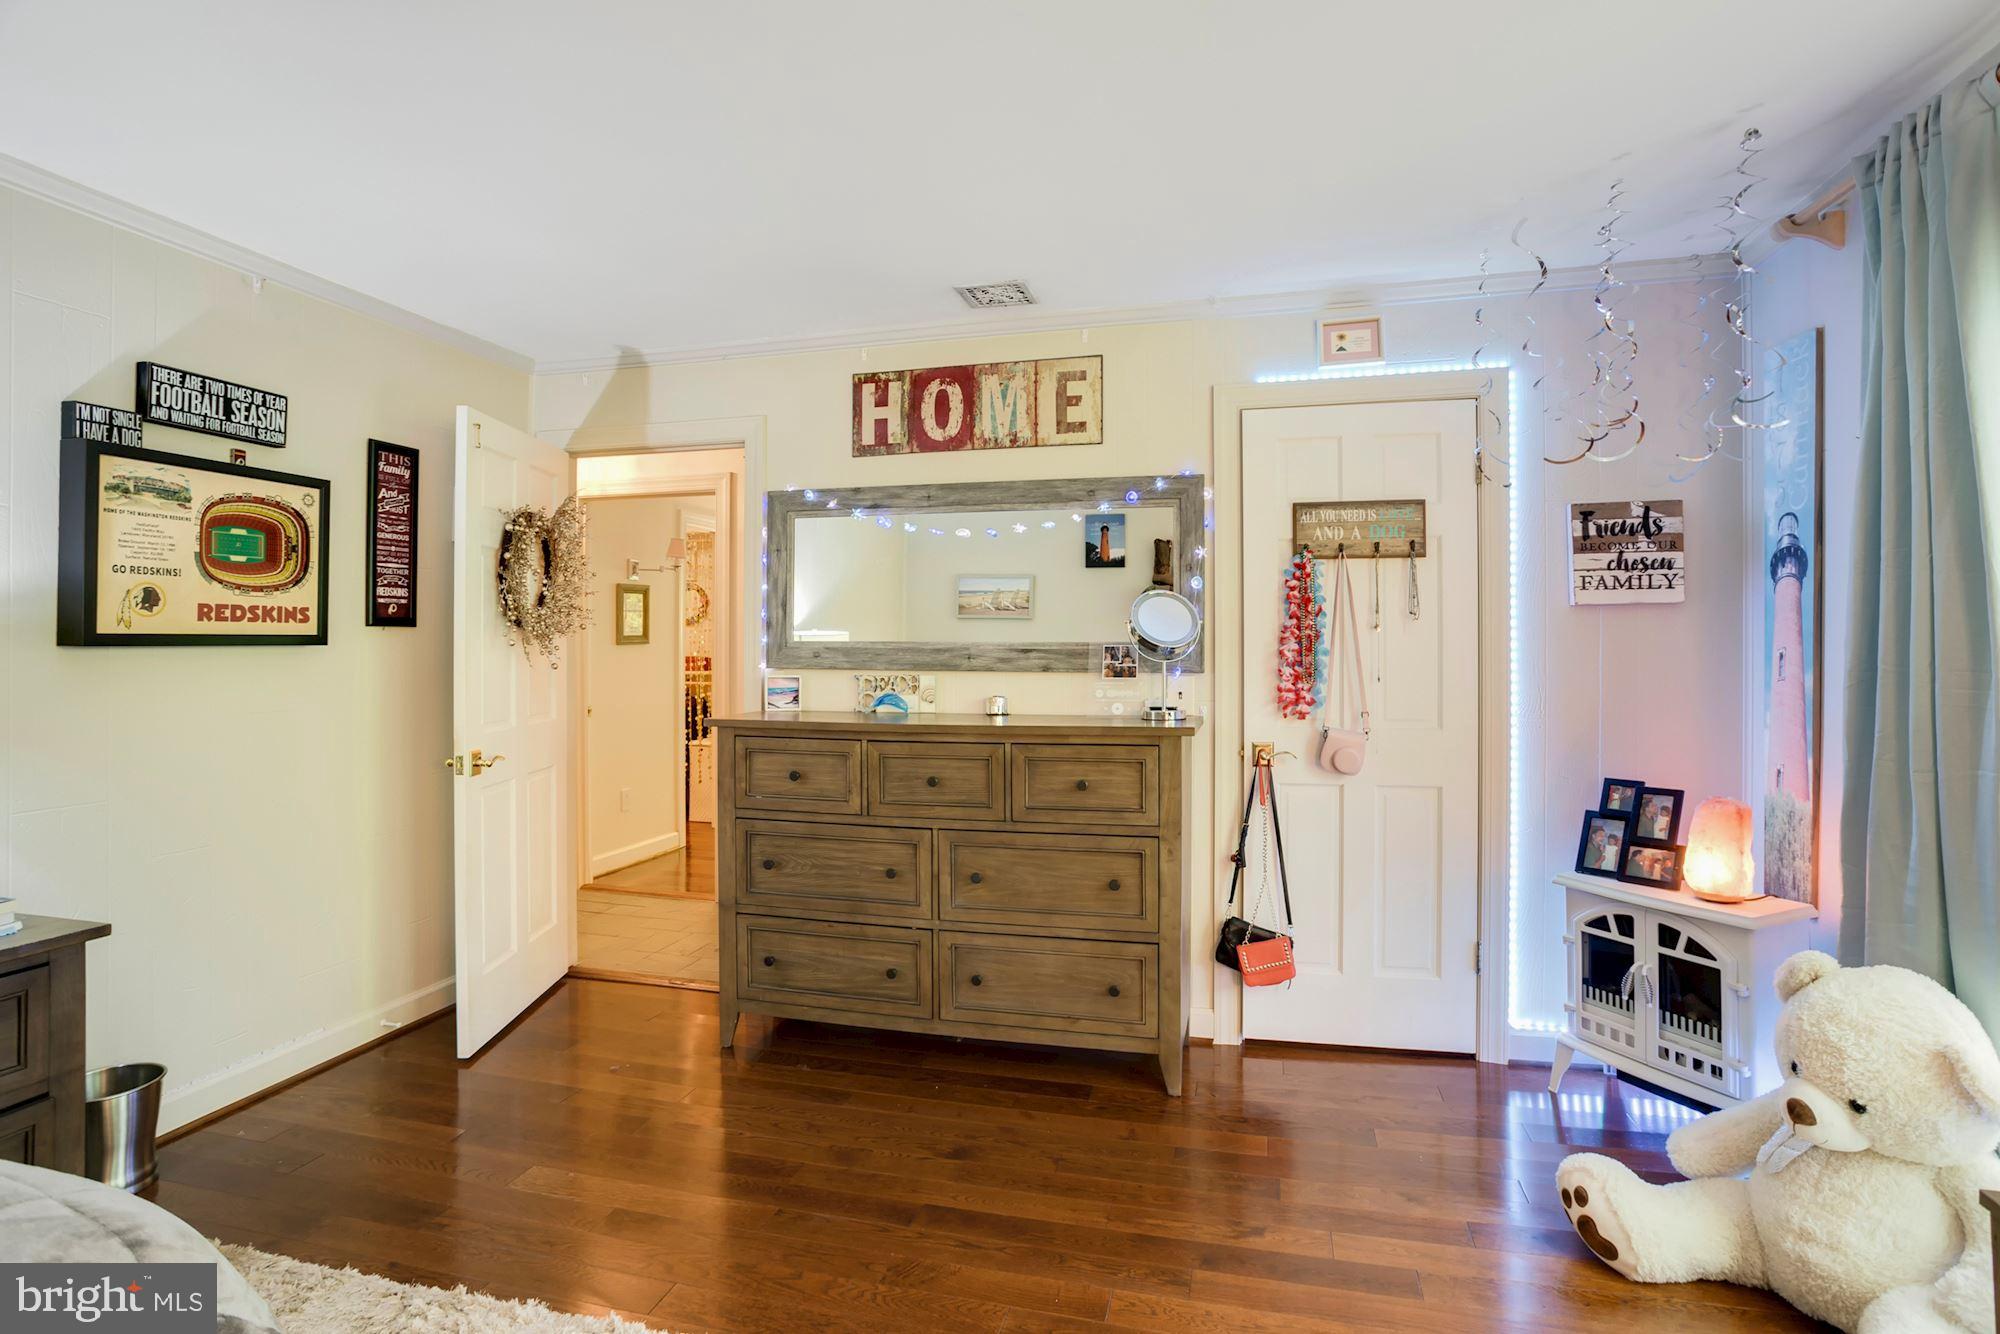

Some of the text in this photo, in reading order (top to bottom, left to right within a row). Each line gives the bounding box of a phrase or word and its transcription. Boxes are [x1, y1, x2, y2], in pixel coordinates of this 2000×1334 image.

[152, 365, 287, 411] THERE ARE TWO TIMES OF YEAR
[76, 402, 142, 430] I'M NOT SINGLE
[151, 380, 286, 433] FOOTBALL SEASON
[861, 370, 1088, 446] HOME
[76, 420, 142, 448] I HAVE A DOG
[150, 405, 286, 445] AND WAITING FOR FOOTBALL SEASON
[378, 450, 412, 467] THIS
[377, 461, 412, 480] Family
[377, 487, 399, 499] And
[1300, 511, 1319, 523] ALL
[1320, 509, 1340, 522] YOU
[1341, 509, 1366, 522] NEED
[1367, 508, 1377, 521] IS
[1579, 505, 1664, 541] Friends
[376, 531, 410, 542] GENEROUS
[1313, 524, 1407, 541] AND A DOG
[1580, 540, 1679, 552] BECOME OUR
[112, 564, 182, 577] GO REDSKINS!
[376, 566, 410, 576] TOGETHER
[1607, 550, 1677, 574] chosen
[1579, 573, 1680, 591] FAMILY
[197, 602, 311, 624] REDSKINS
